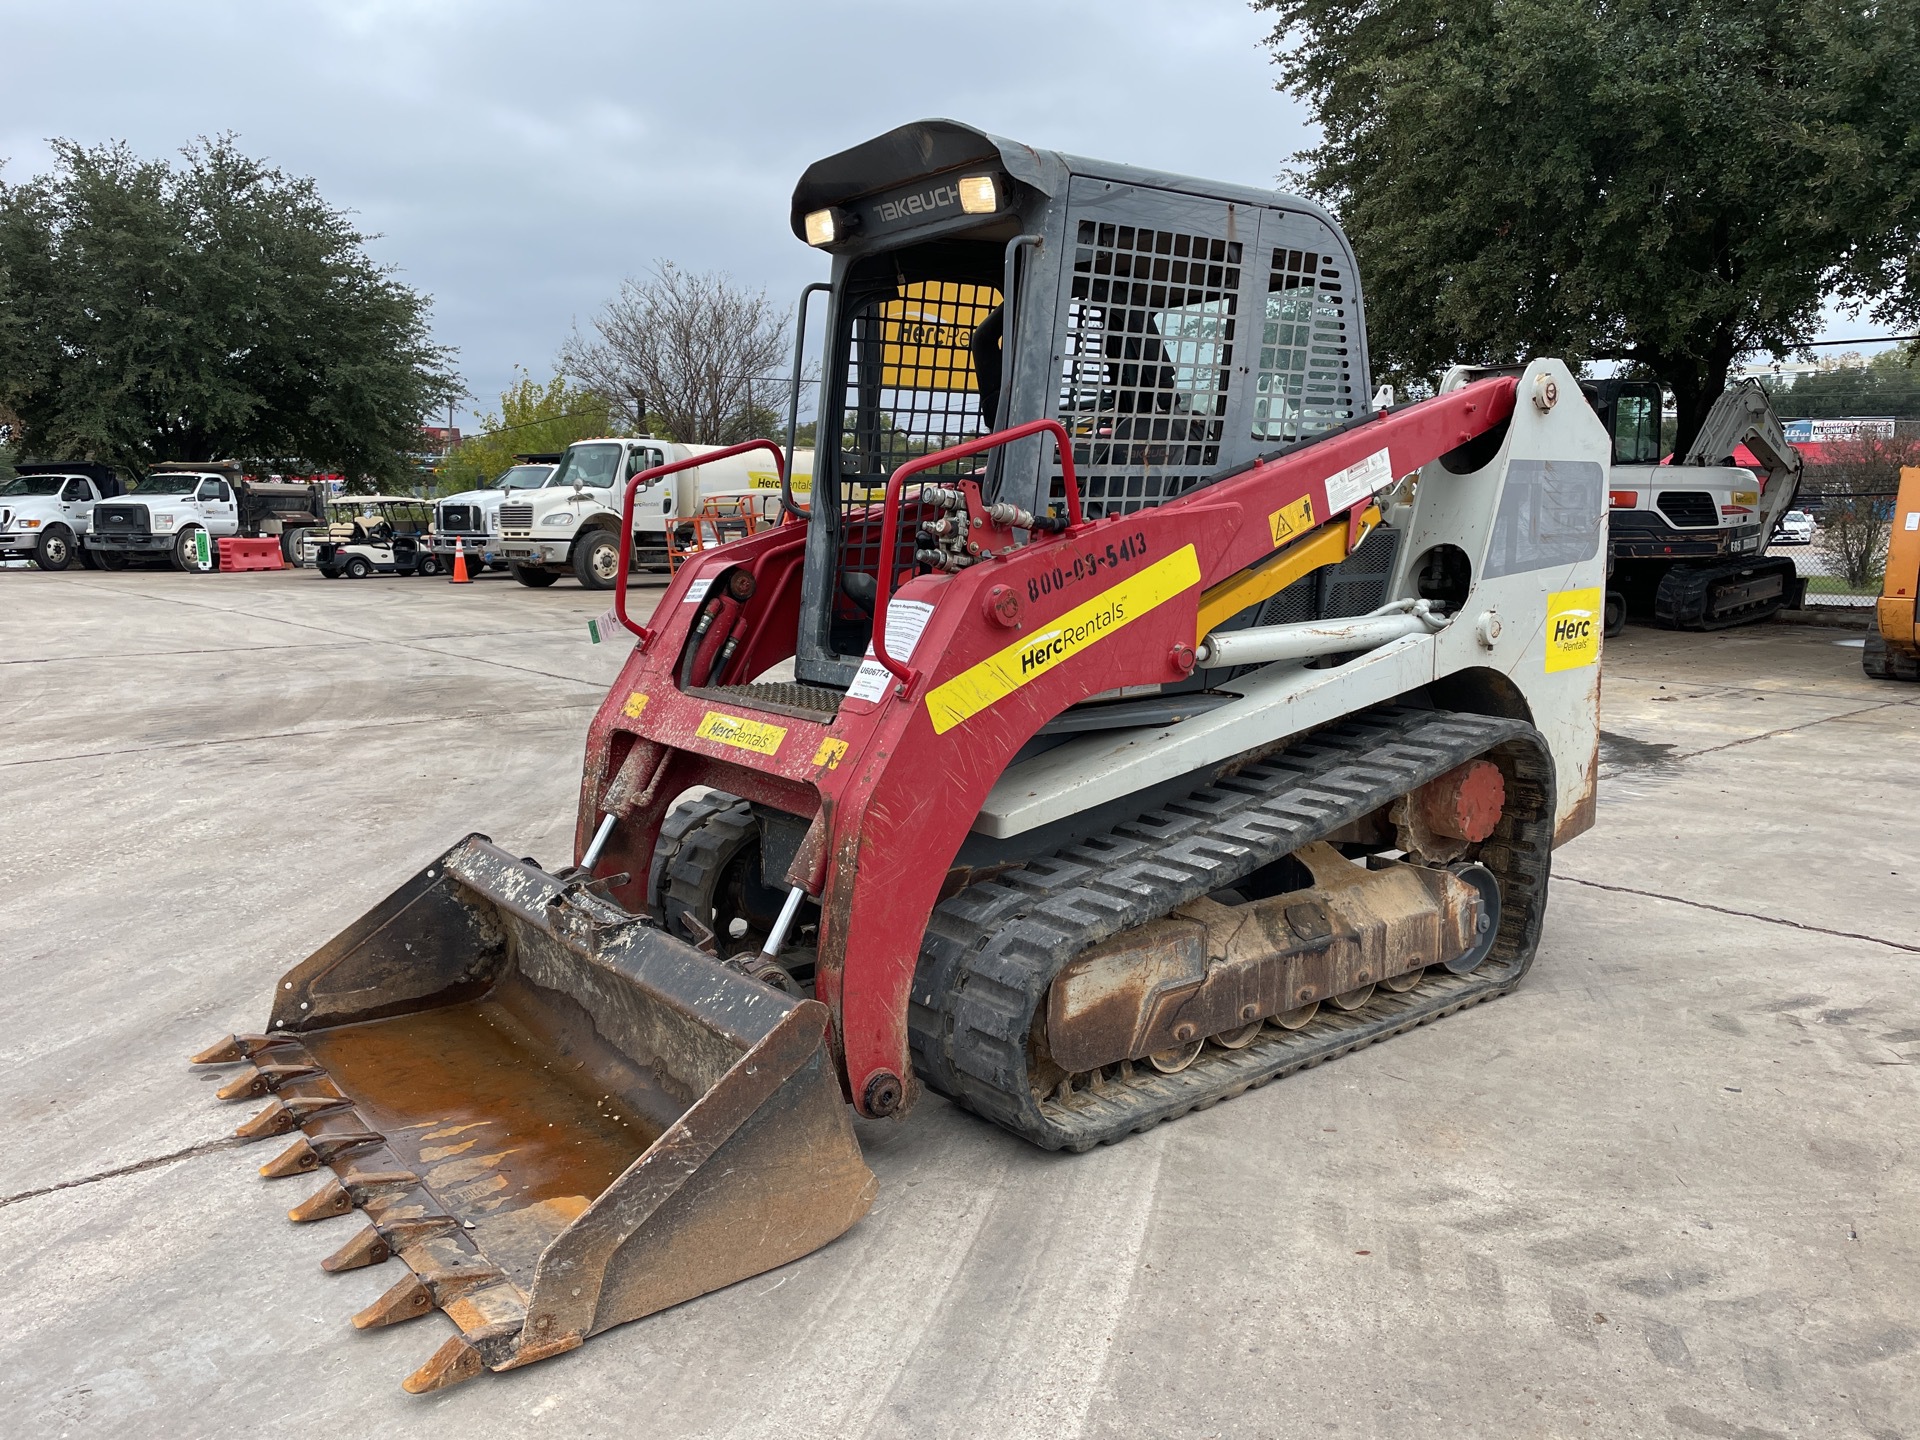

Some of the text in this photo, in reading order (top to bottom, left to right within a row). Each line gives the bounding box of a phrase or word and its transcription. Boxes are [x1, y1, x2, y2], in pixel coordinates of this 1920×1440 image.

[1814, 426, 1856, 435] ALIGNMENT
[1027, 532, 1147, 604] 800-09-5413
[1021, 602, 1124, 675] HercRentals
[1553, 619, 1591, 642] Herc
[1562, 639, 1588, 652] Rentals
[707, 721, 770, 748] HercRentals
